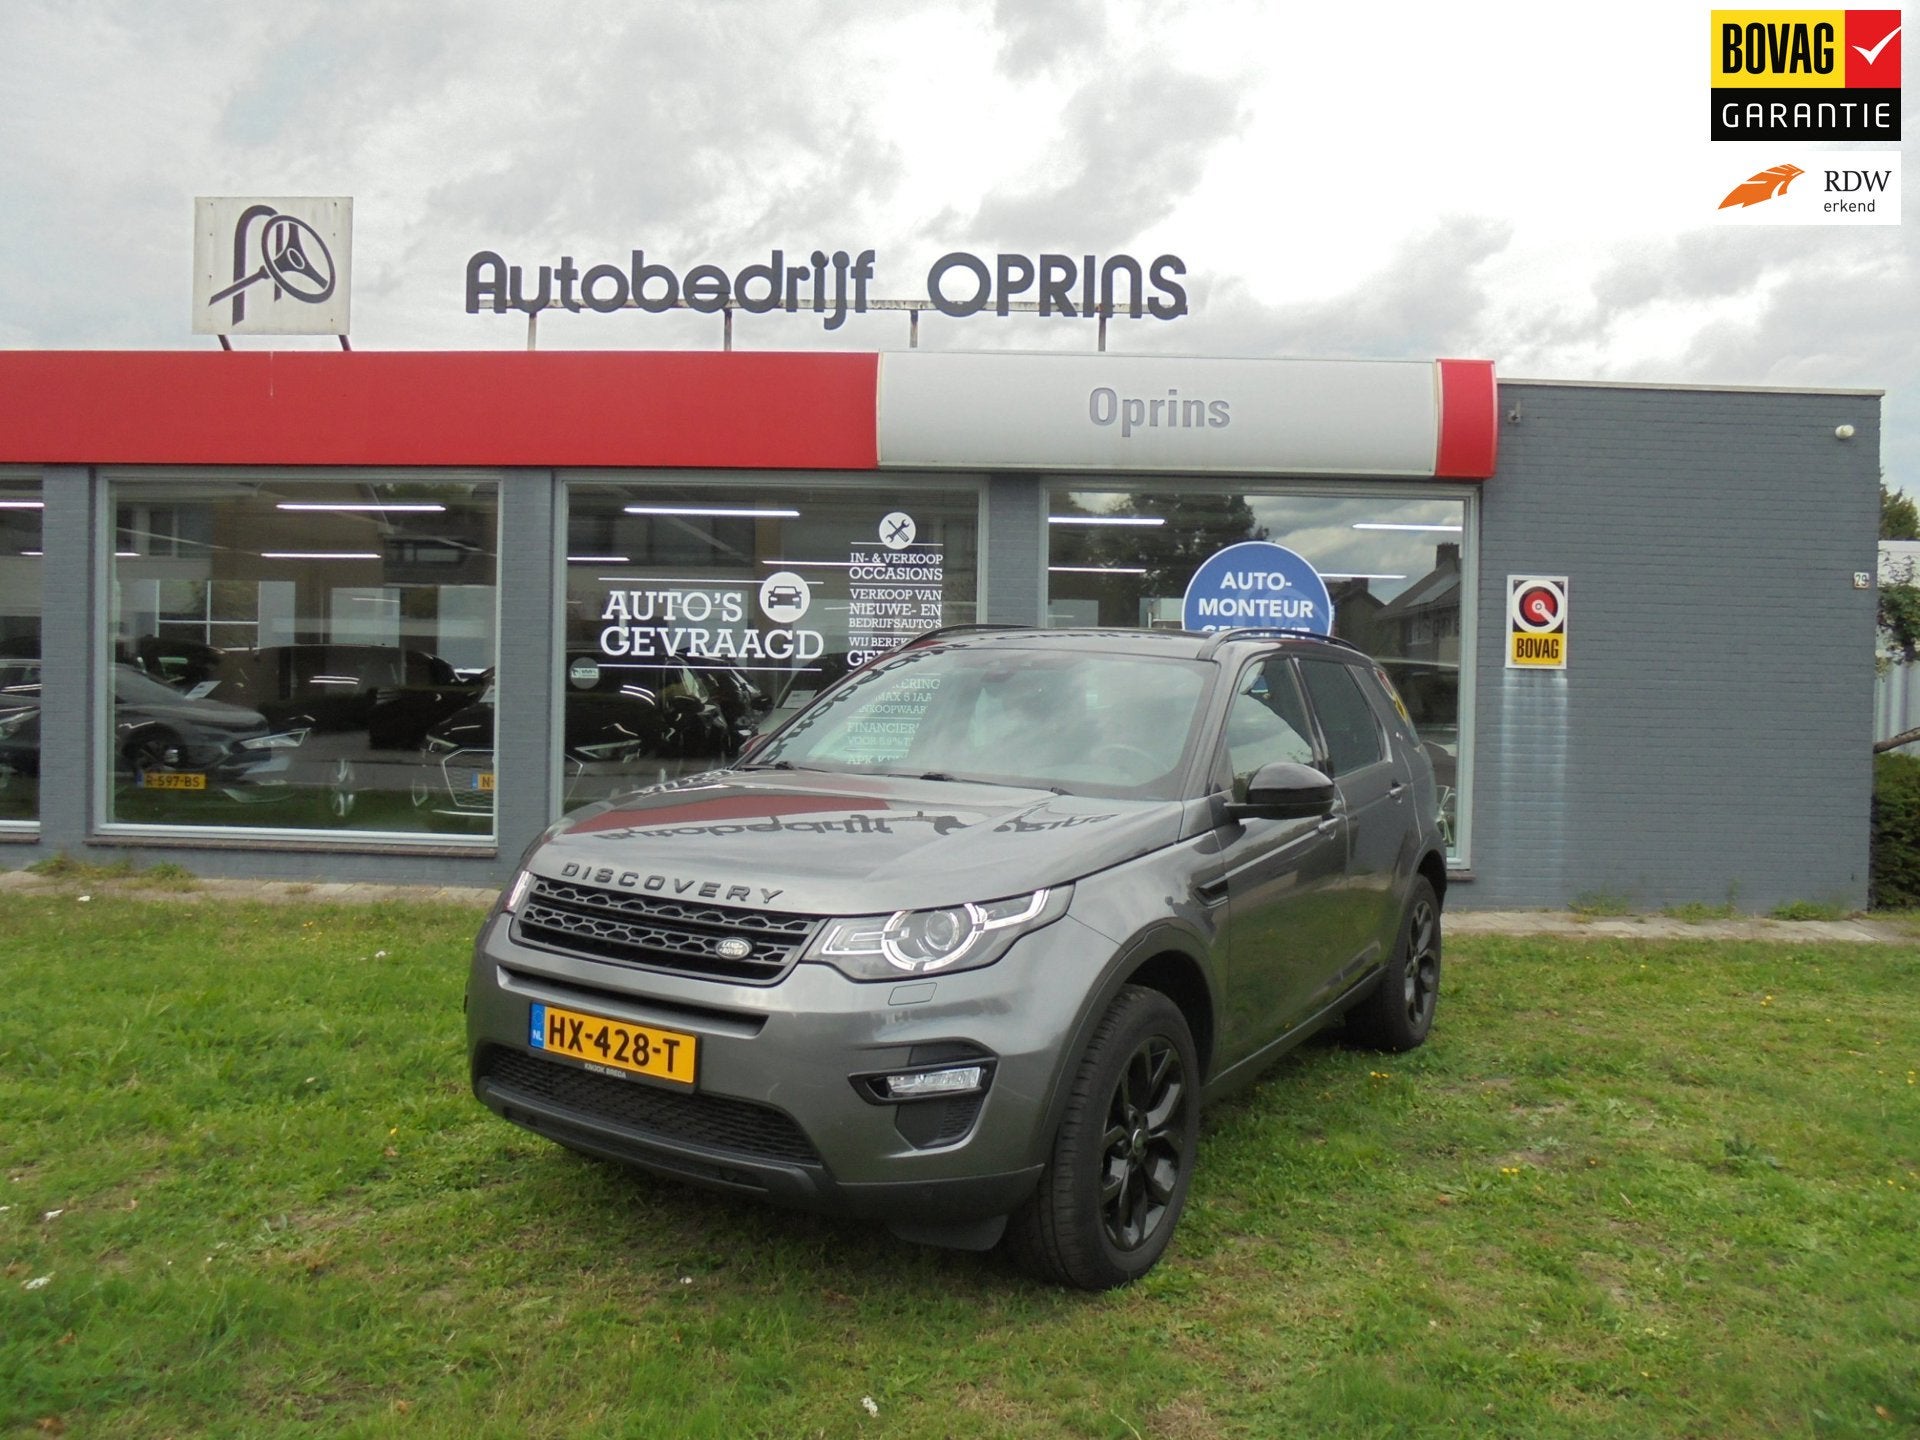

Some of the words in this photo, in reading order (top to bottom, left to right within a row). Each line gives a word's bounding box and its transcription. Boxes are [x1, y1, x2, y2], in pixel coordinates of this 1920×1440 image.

[466, 249, 875, 330] Autobedrijf
[927, 251, 1188, 319] OPRINS
[1089, 387, 1231, 438] Oprins
[872, 553, 881, 563] &
[883, 553, 944, 565] VERKOOP
[849, 567, 943, 581] OCCASIONS
[1220, 571, 1292, 591] AUTO-
[850, 589, 913, 600] VERKOOP
[915, 590, 942, 601] VAN
[602, 590, 743, 623] AUTO'S
[849, 602, 917, 616] NIEUWE-
[920, 604, 942, 616] EN
[1198, 598, 1314, 619] MONTEUR
[848, 617, 942, 629] BEDRIJFSAUTO'S
[600, 626, 824, 660] GEVRAAGD
[1516, 637, 1560, 660] BOVAG
[847, 721, 920, 735] FINANCIER
[561, 861, 784, 904] DISCOVERY
[532, 1029, 543, 1041] NL
[549, 1014, 681, 1073] HX-428-T
